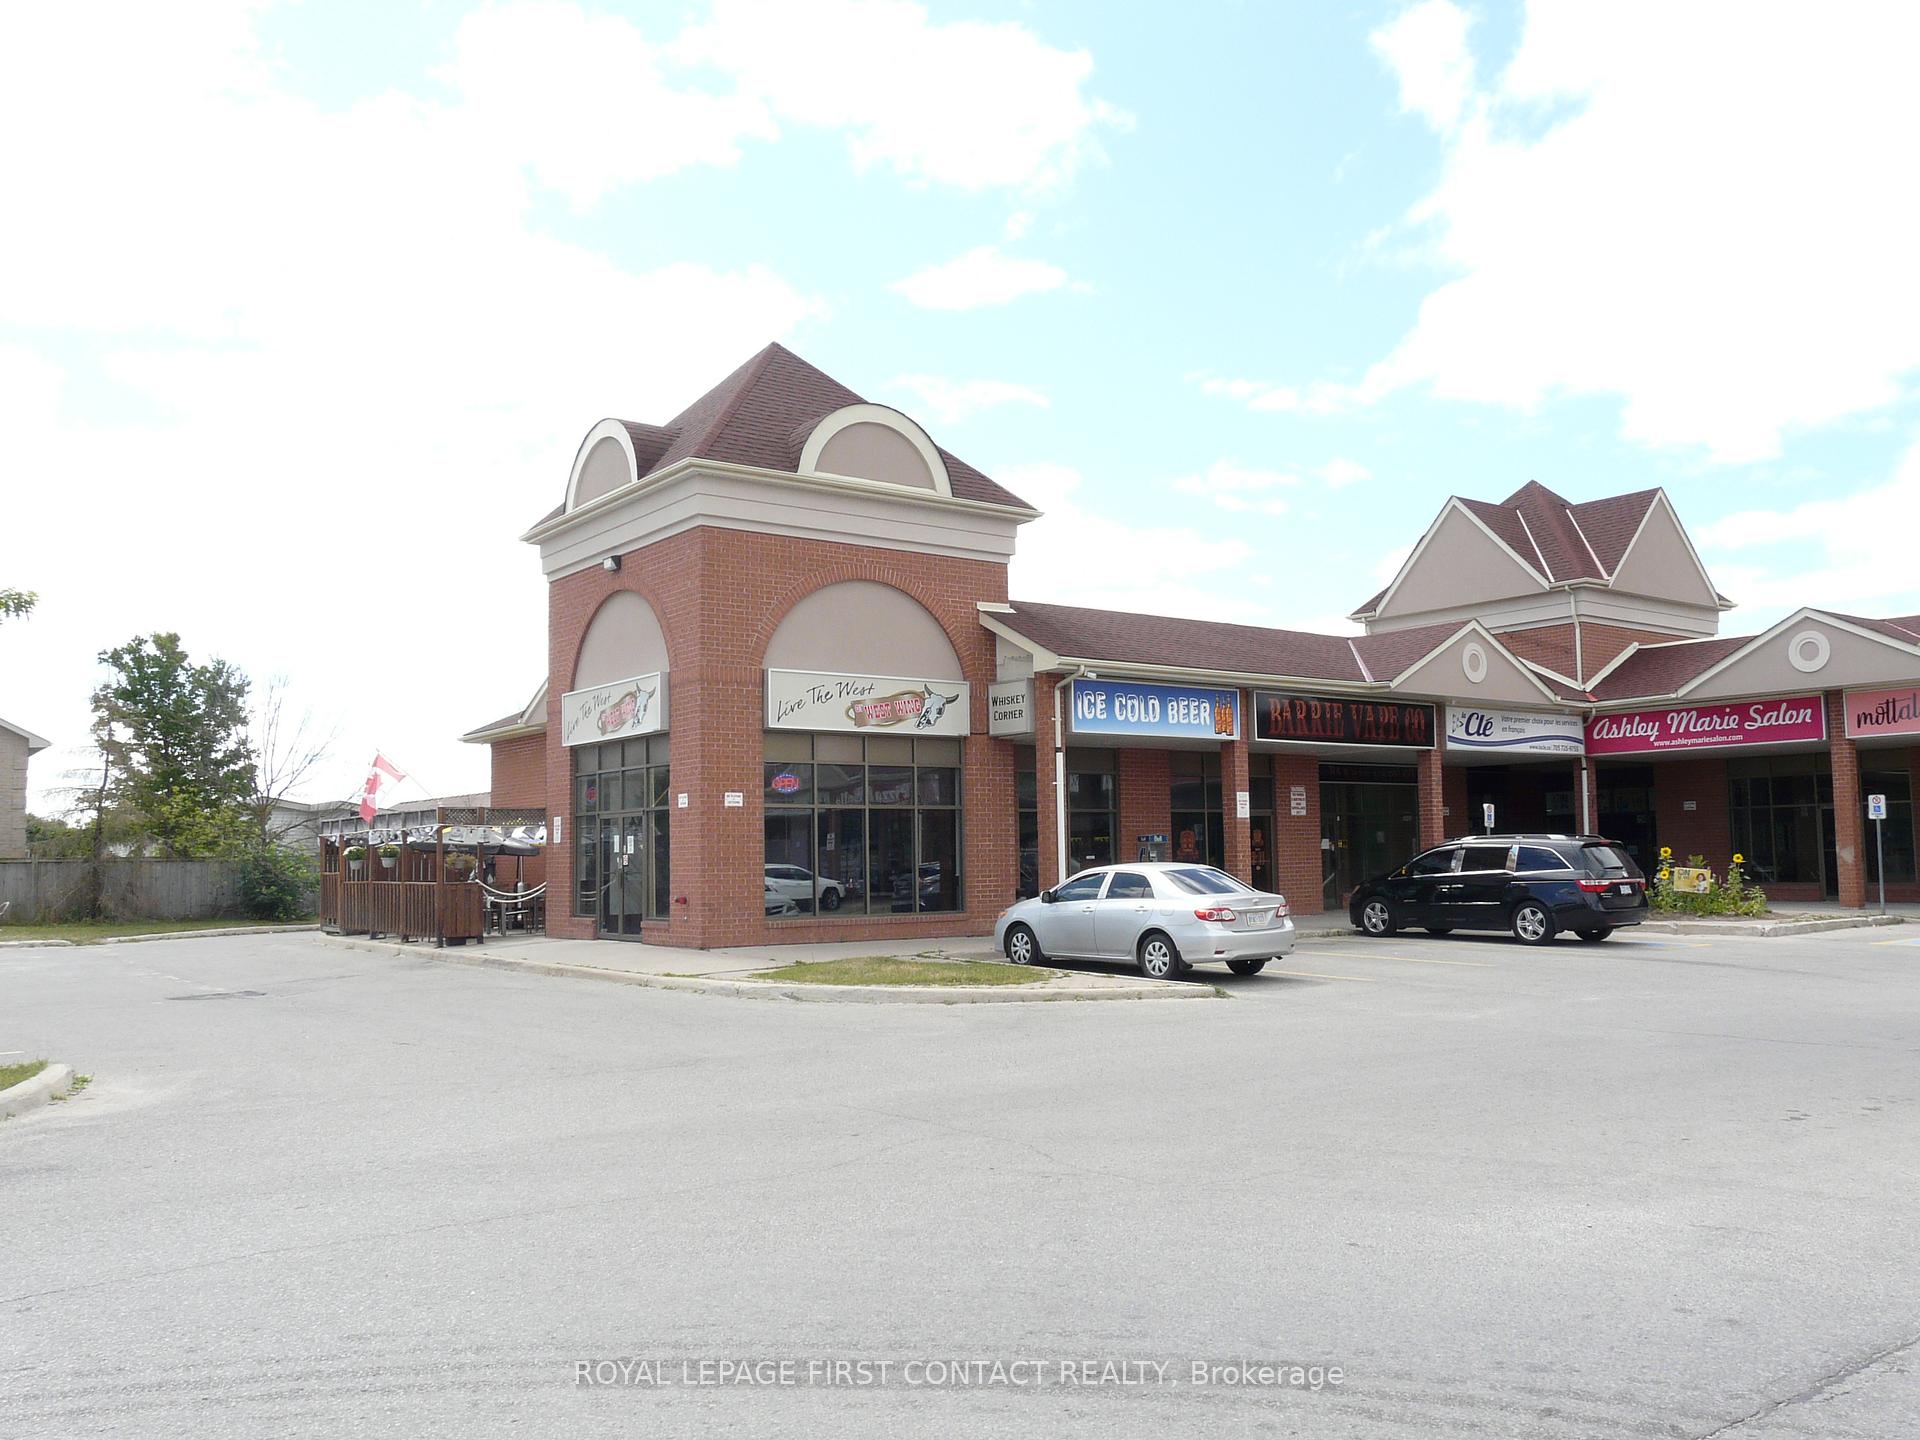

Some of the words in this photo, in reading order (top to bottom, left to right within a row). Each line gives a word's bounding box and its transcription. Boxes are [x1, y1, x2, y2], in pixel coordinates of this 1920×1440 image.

[777, 699, 806, 722] Live
[806, 684, 833, 705] The
[836, 681, 875, 698] West
[864, 702, 892, 720] WEST
[894, 698, 921, 716] WING
[1077, 691, 1107, 720] ICE
[1114, 693, 1160, 723] COLD
[1167, 697, 1210, 726] BEER
[1268, 698, 1344, 737] BARRIE
[1350, 704, 1399, 740] VAPE
[1857, 692, 1920, 728] mottal
[1465, 712, 1494, 737] Clé
[1593, 716, 1660, 742] Ashley
[1667, 708, 1738, 734] Marie
[1744, 703, 1812, 729] Salon
[1653, 734, 1743, 747] www.ashleymariesalon.com
[772, 776, 800, 789] OPEN
